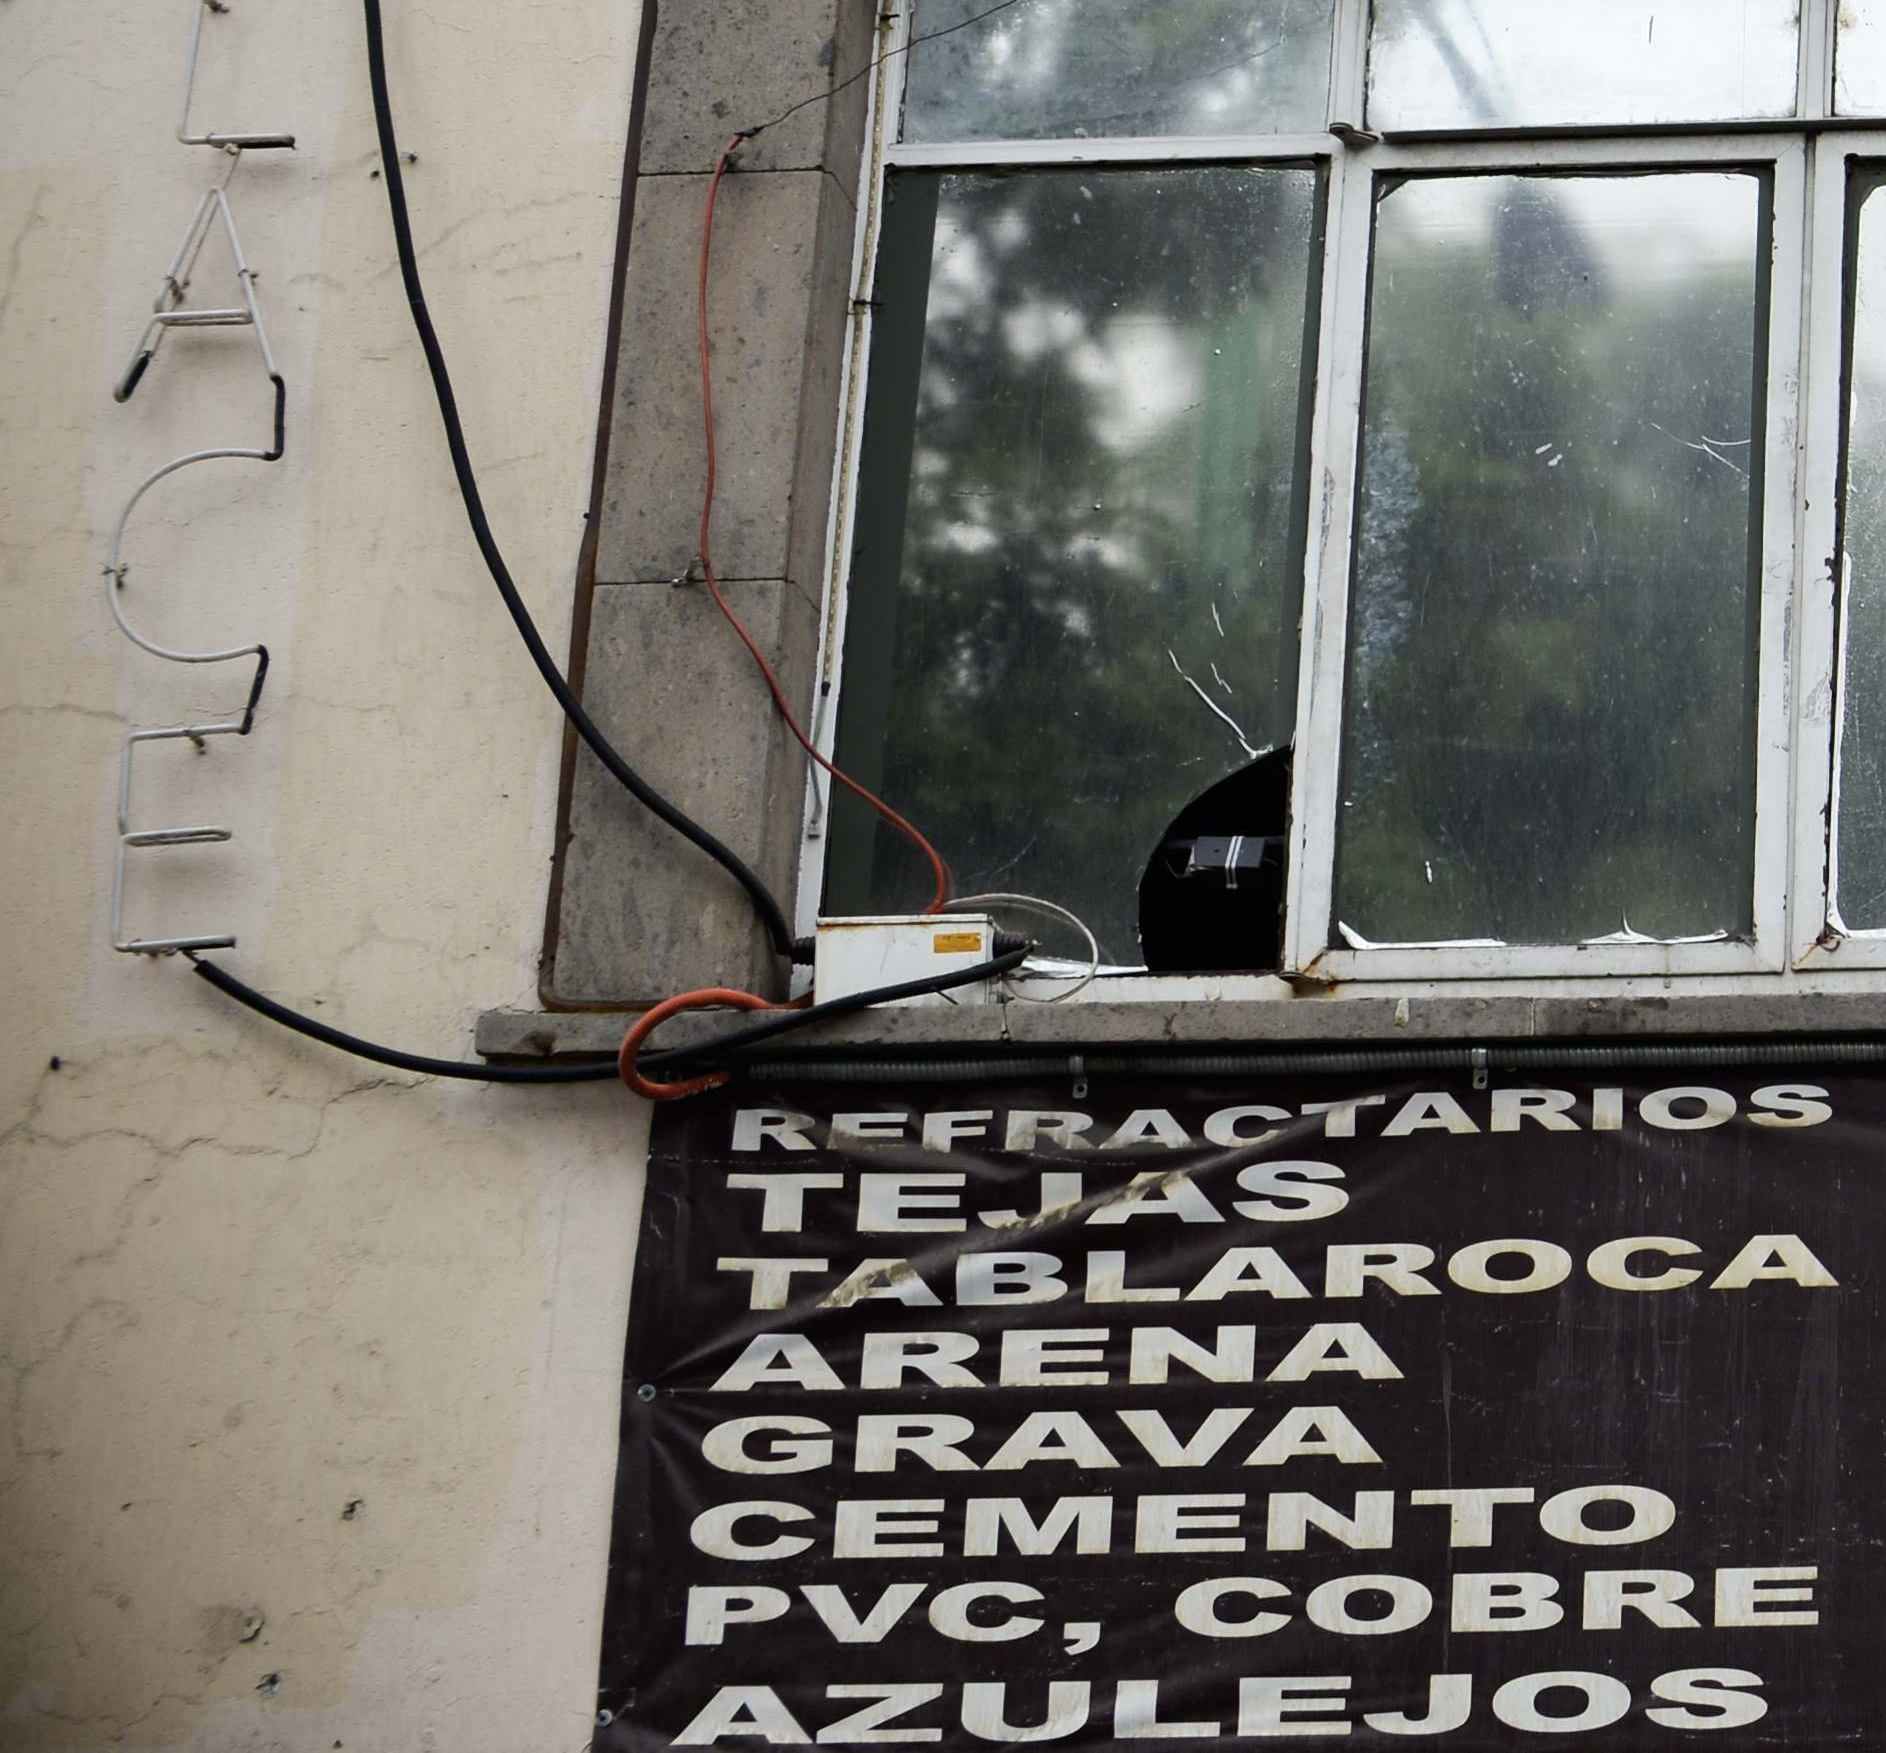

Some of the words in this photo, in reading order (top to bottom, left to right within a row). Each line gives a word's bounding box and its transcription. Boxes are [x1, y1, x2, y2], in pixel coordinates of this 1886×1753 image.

[730, 1083, 1834, 1152] REFRACTARIOS
[726, 1160, 1350, 1233] TEJAS
[716, 1234, 1839, 1310] TABLAROCA
[709, 1321, 1405, 1391] ARENA
[700, 1405, 1383, 1475] GRAVA
[688, 1484, 1678, 1562] CEMENTO
[683, 1581, 1102, 1656] PVC,
[1174, 1566, 1820, 1643] COBRE
[670, 1666, 1769, 1746] AZULEJOS
